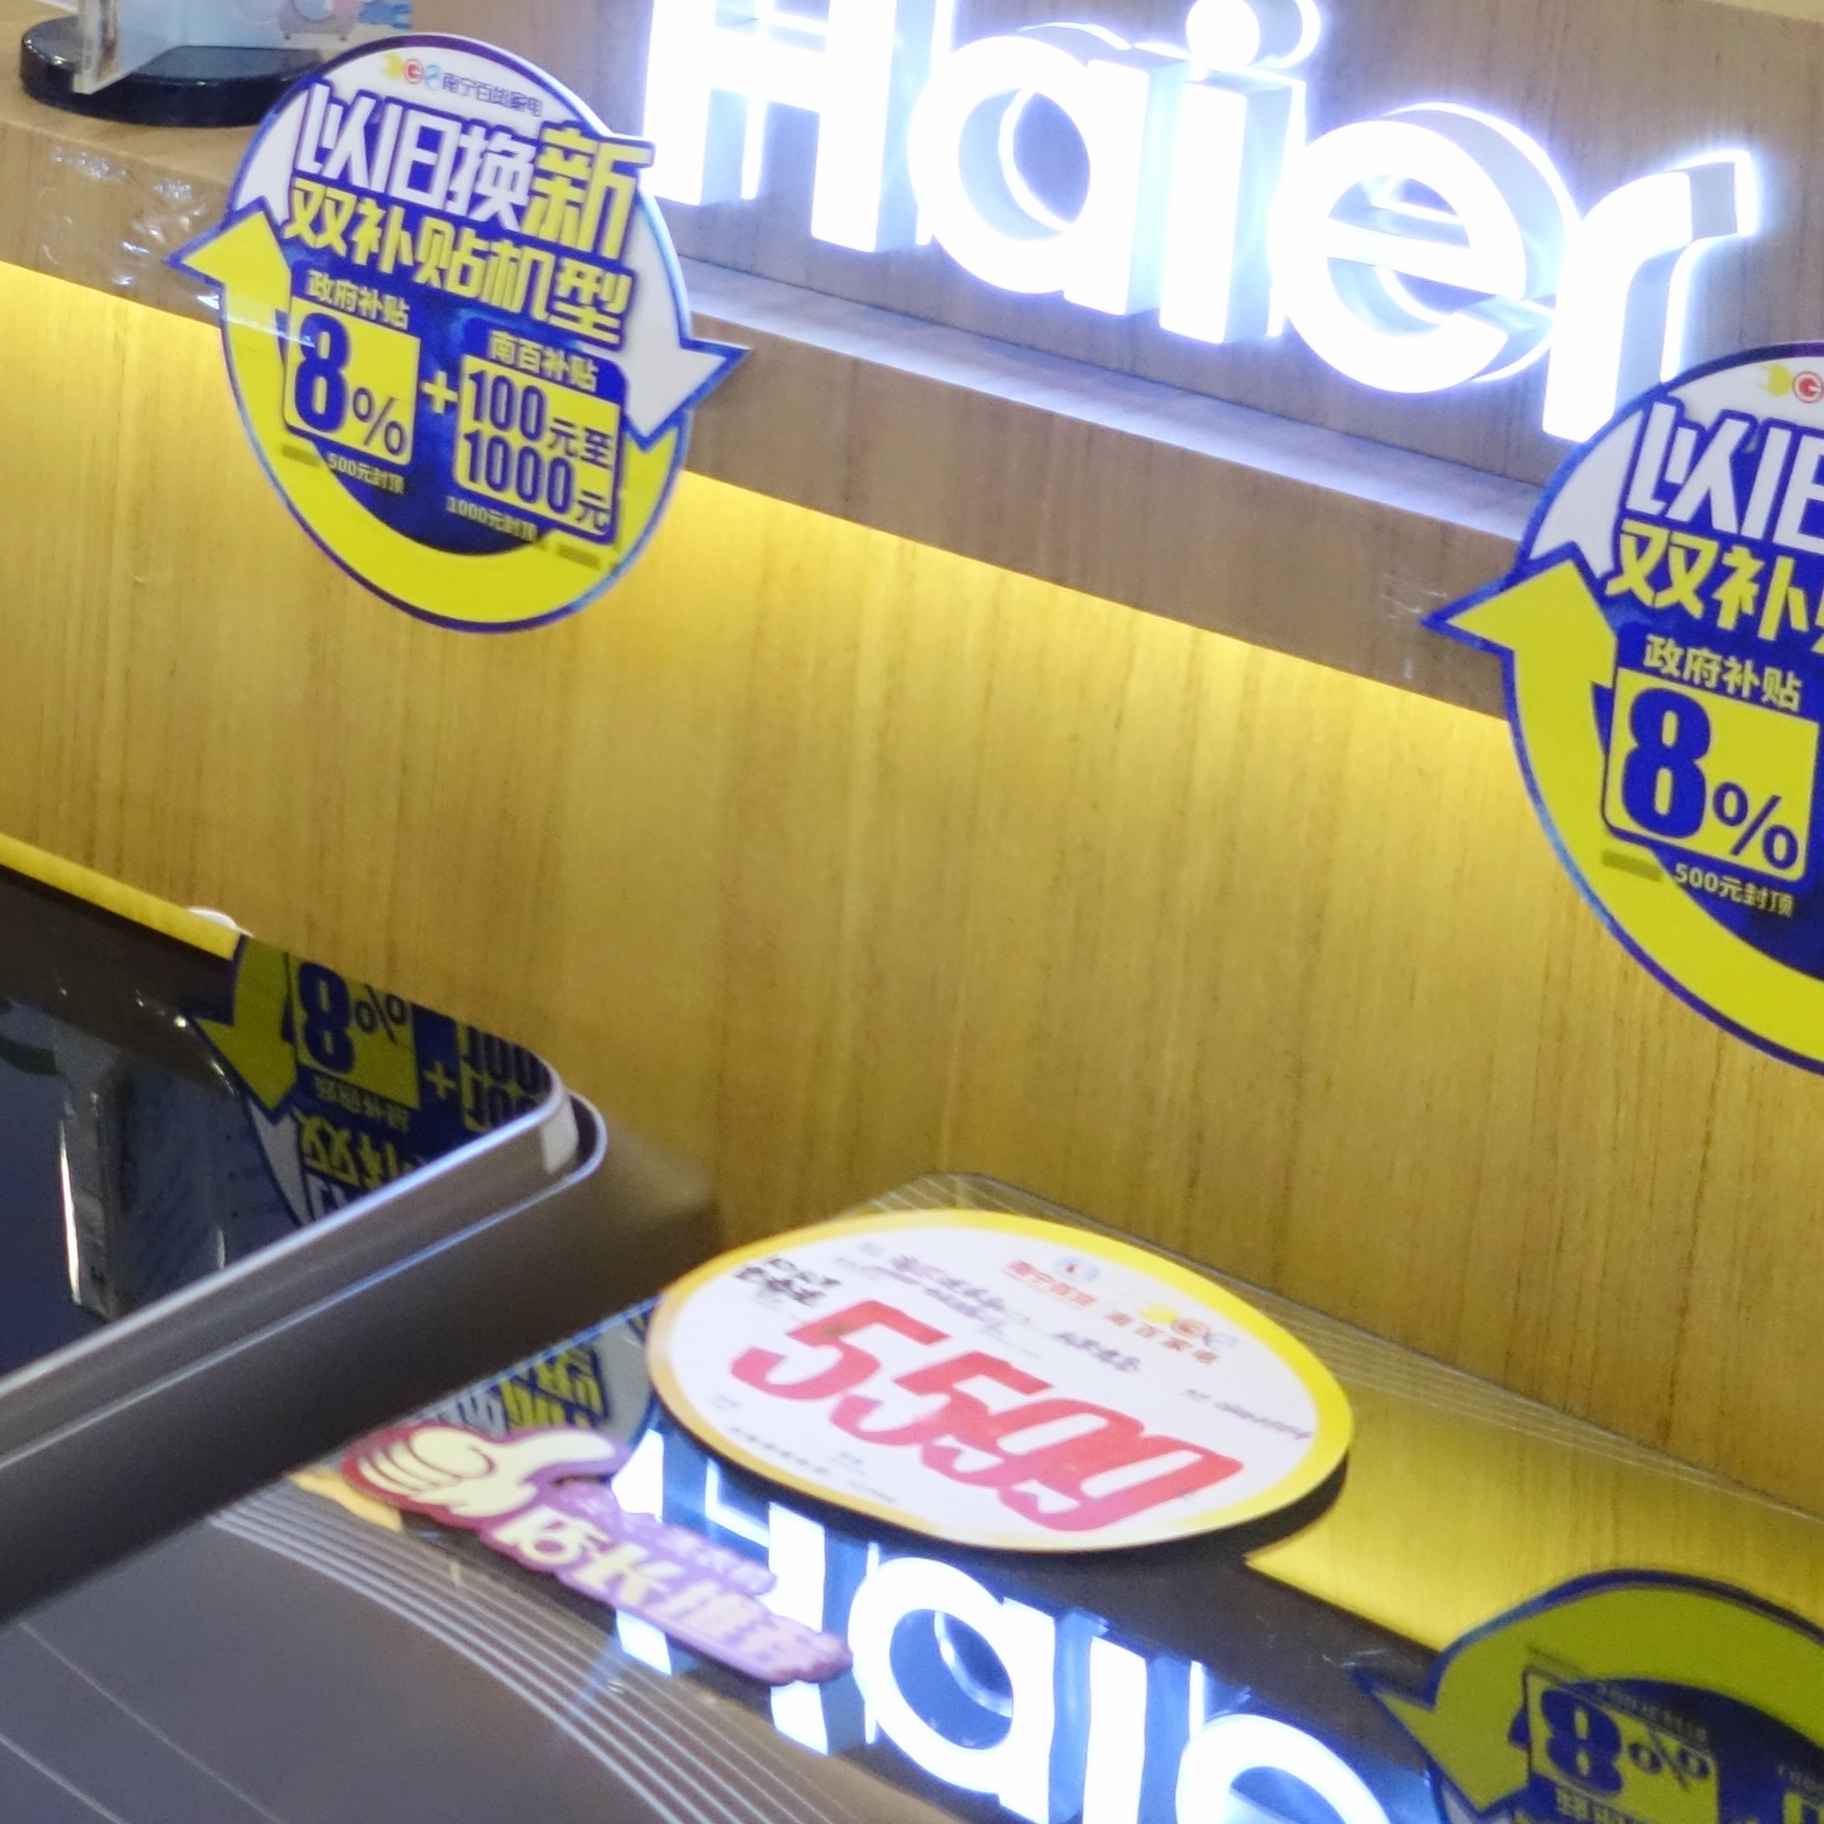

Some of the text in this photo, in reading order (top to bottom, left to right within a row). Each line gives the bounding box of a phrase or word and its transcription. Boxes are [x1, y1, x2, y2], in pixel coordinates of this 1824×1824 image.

[294, 80, 654, 262] 以旧换新
[283, 178, 634, 348] 双补贴机型
[306, 268, 411, 331] 政府补贴
[293, 312, 408, 458] 8%
[487, 330, 598, 394] 南百补贴
[467, 369, 614, 472] 100元至
[461, 429, 611, 536] 1000元
[1604, 519, 1824, 656] 双补
[1644, 633, 1803, 713] 政府补贴
[1621, 687, 1799, 872] 8%
[1674, 860, 1795, 920] 500元封顶
